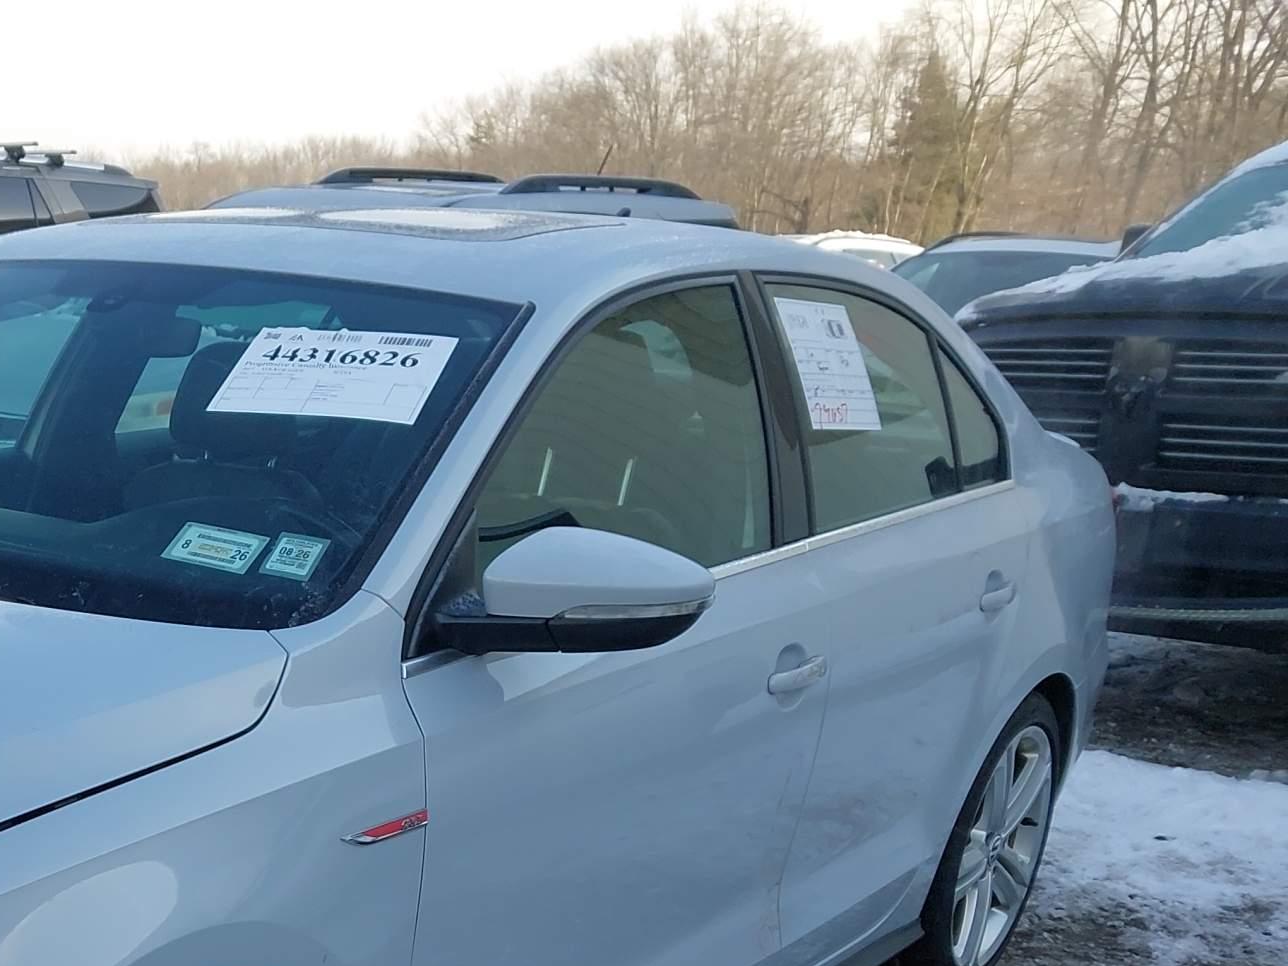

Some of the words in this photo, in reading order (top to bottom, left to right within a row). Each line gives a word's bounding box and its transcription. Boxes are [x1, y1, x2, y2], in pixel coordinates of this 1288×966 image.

[262, 344, 421, 368] 44316826
[181, 539, 193, 550] 8
[229, 549, 250, 562] 26
